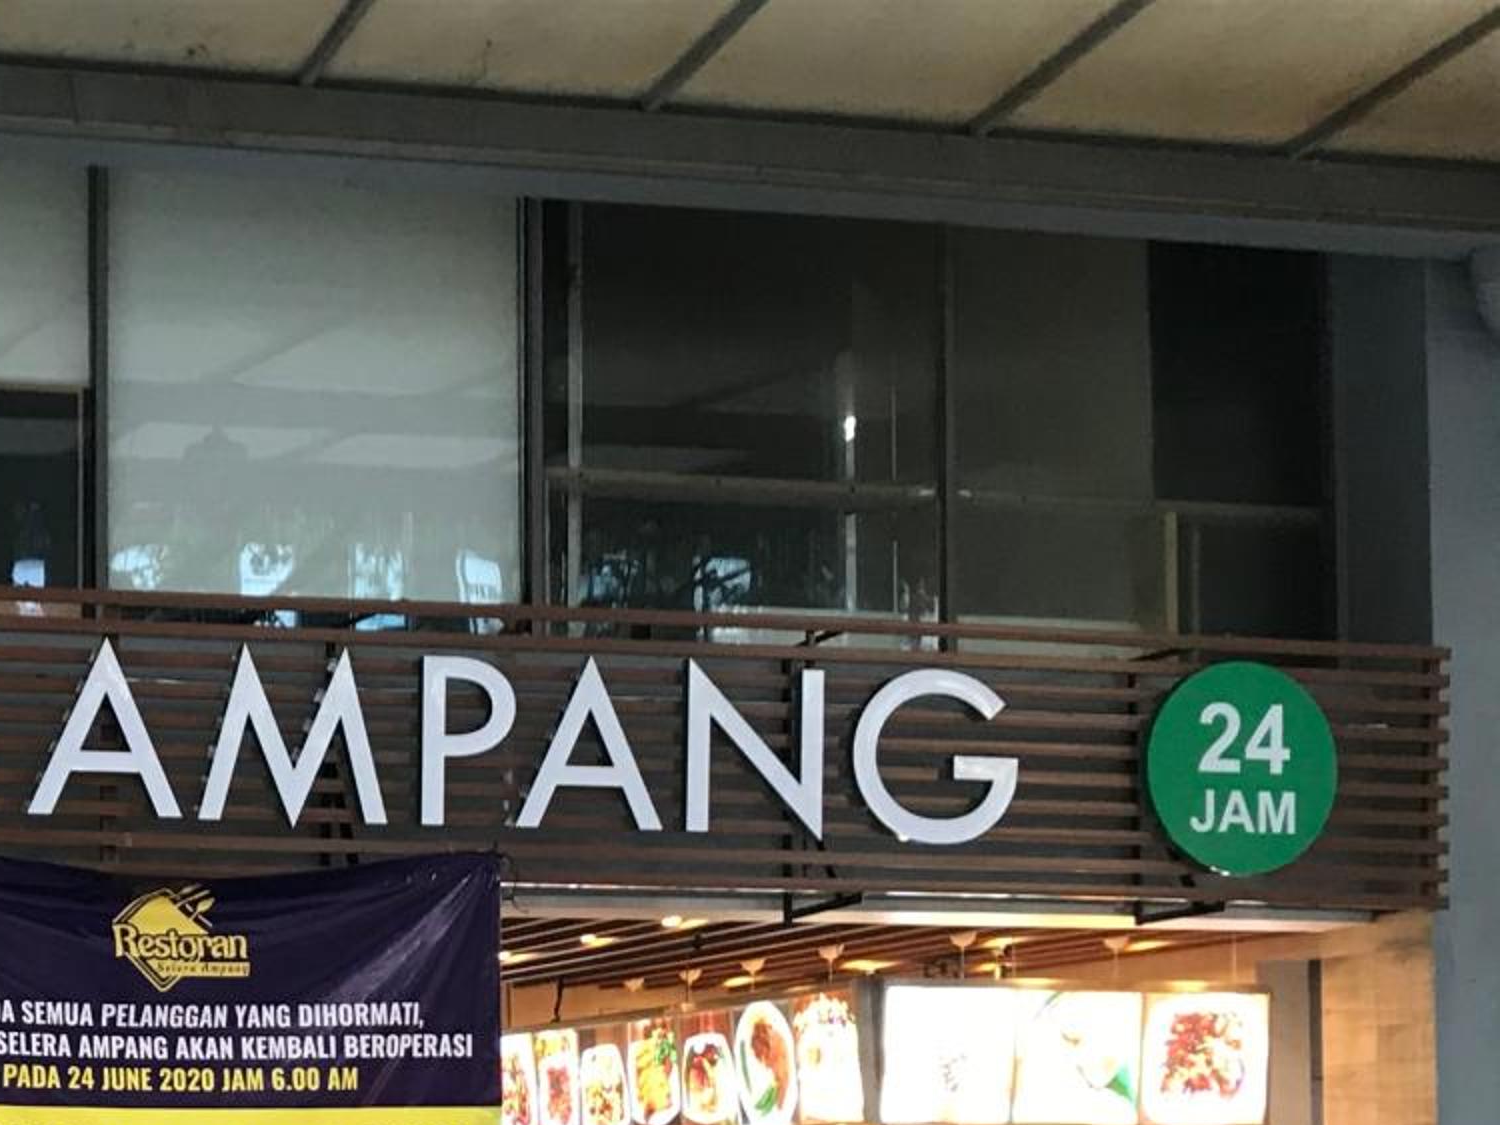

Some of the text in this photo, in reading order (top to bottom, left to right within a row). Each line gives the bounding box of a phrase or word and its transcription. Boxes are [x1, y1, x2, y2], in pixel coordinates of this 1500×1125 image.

[27, 637, 1019, 844] AMPANG
[1197, 702, 1291, 775] 24
[1189, 789, 1296, 835] JAM
[112, 924, 247, 960] Restoran
[21, 1000, 94, 1026] SEMUA
[100, 1003, 228, 1029] PELANGGAN
[235, 1004, 291, 1029] YANG
[298, 1001, 425, 1029] DIHORMATI,
[78, 1034, 169, 1060] AMPANG
[175, 1036, 233, 1060] AKAN
[241, 1035, 336, 1060] KEMBALI
[344, 1033, 473, 1059] BEROPERASI
[3, 1063, 359, 1092] PADA 24 JUNE 2020 JAM 6.00 AM
